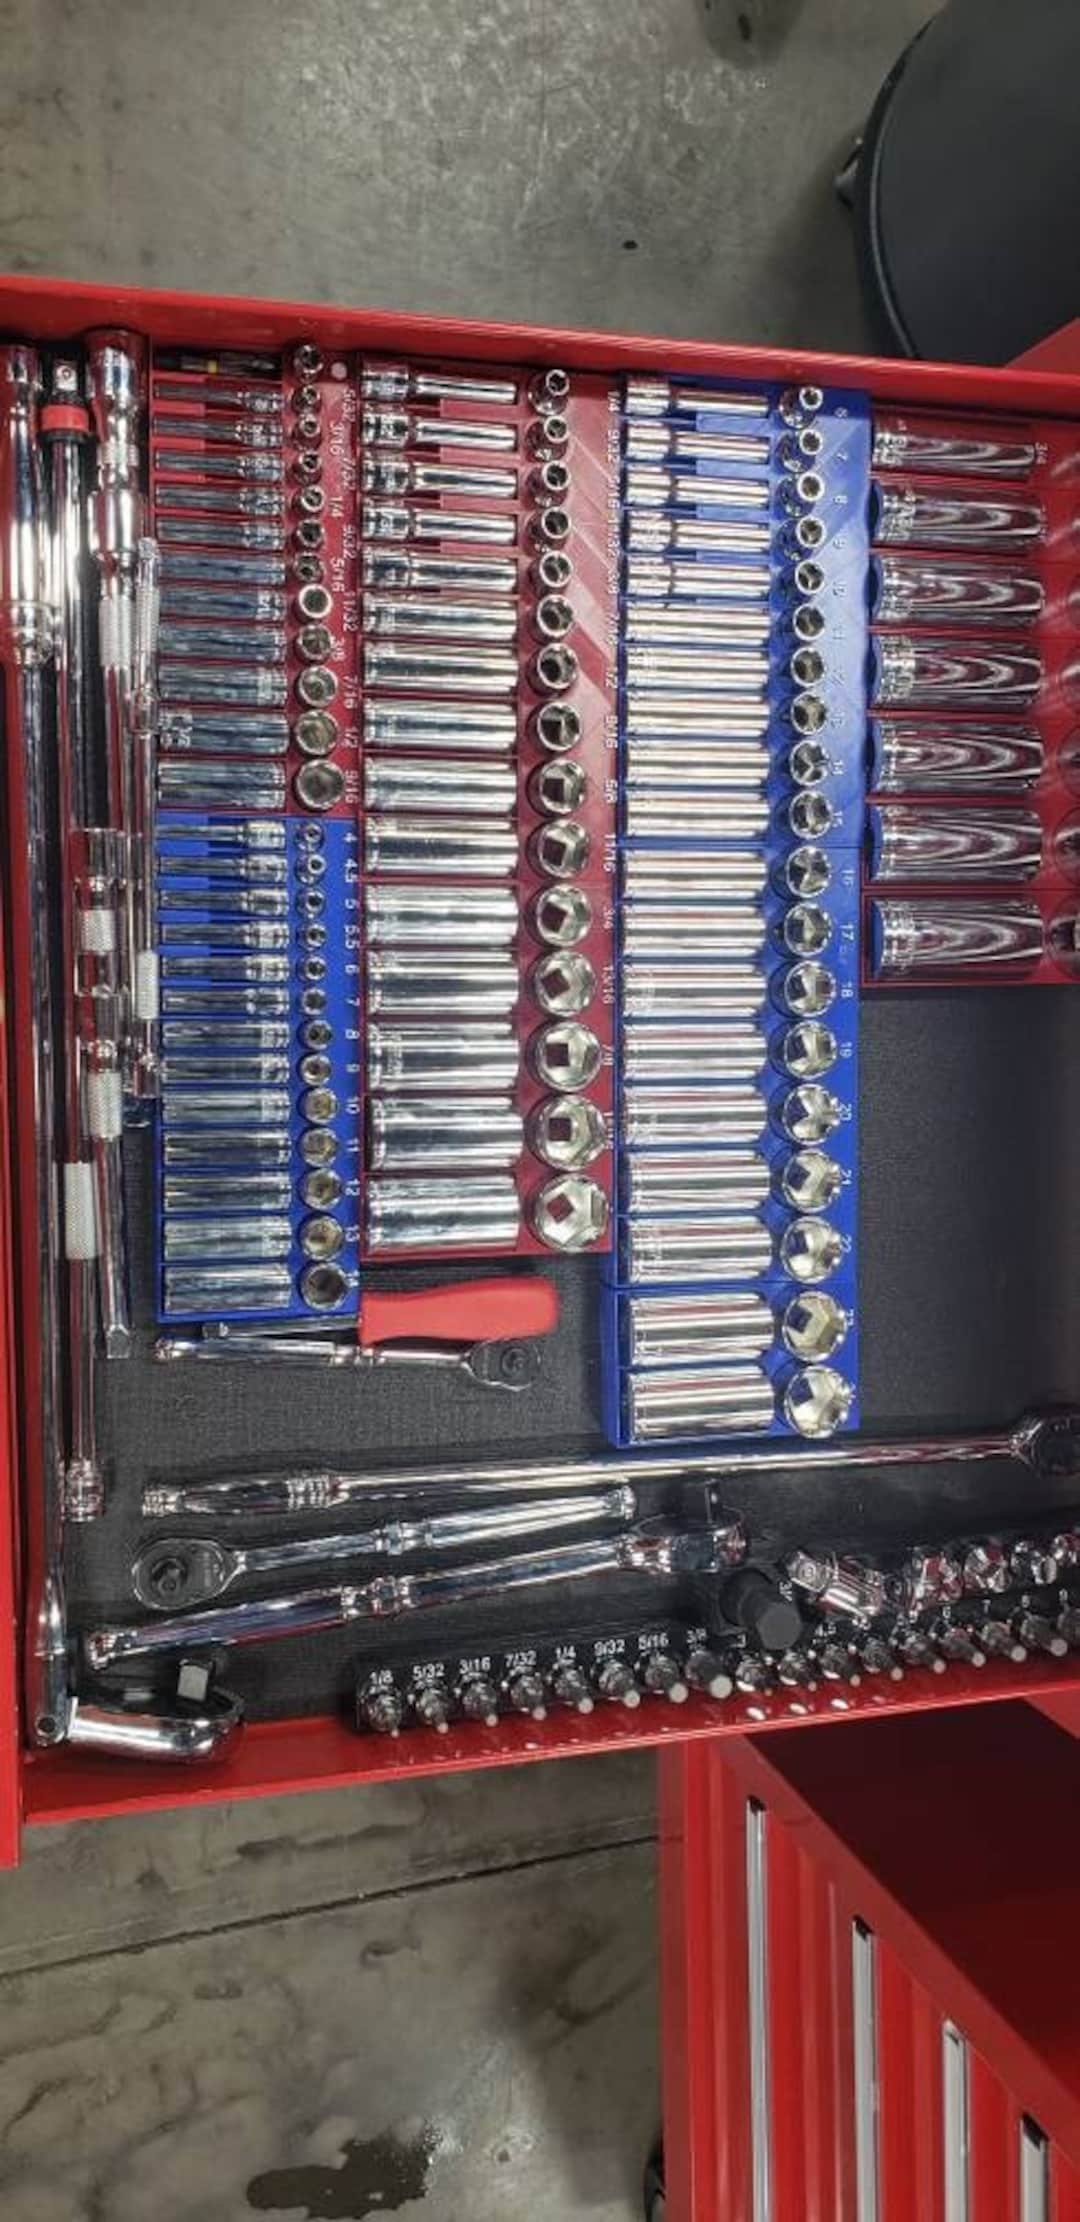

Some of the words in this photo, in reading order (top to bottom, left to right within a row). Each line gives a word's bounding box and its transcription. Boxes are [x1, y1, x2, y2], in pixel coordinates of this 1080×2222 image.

[343, 389, 355, 422] 5/32
[608, 391, 620, 412] 1/4
[330, 421, 344, 456] 3/16
[608, 429, 620, 463] 9/32
[1035, 442, 1048, 464] 3/4
[343, 457, 355, 490] 7/32
[608, 475, 621, 508] 5/16
[834, 495, 848, 504] 8
[330, 495, 343, 517] 1/4
[343, 525, 355, 559] 9/32
[608, 517, 620, 557] 11/32
[331, 557, 344, 592] 5/16
[607, 569, 620, 594] 3/8
[343, 590, 356, 631] 11/32
[607, 612, 620, 645] 7/16
[331, 637, 345, 661] 3/8
[606, 666, 618, 688] 1/2
[344, 675, 357, 709] 7/16
[345, 725, 357, 748] 1/2
[605, 715, 618, 748] 9/16
[831, 760, 844, 775] 14
[345, 770, 358, 803] 9/16
[605, 778, 618, 803] 5/8
[345, 832, 357, 843] 4
[604, 833, 616, 873] 11/16
[345, 858, 358, 883] 4.5
[345, 898, 358, 909] 5
[603, 906, 616, 929] 3/4
[345, 924, 359, 949] 5.5
[839, 924, 854, 941] 17
[345, 964, 358, 974] 6
[603, 966, 616, 1003] 13/16
[840, 982, 854, 998] 18
[346, 997, 360, 1006] 7
[345, 1028, 360, 1039] 8
[840, 1042, 852, 1058] 19
[346, 1063, 360, 1073] 9
[345, 1096, 360, 1114] 10
[840, 1103, 852, 1121] 20
[346, 1138, 359, 1152] 11
[841, 1169, 852, 1184] 21
[345, 1178, 360, 1196] 12
[345, 1225, 360, 1242] 13
[841, 1234, 852, 1253] 22
[347, 1269, 360, 1287] 14
[1021, 1594, 1030, 1608] 8
[638, 1633, 669, 1650] 5/16
[687, 1628, 707, 1643] 3/8
[556, 1645, 576, 1658] 1/4
[594, 1639, 625, 1656] 9/32
[459, 1657, 490, 1674] 3/16
[505, 1650, 536, 1667] 7/32
[370, 1670, 393, 1685] 1/8
[413, 1663, 444, 1680] 5/32
